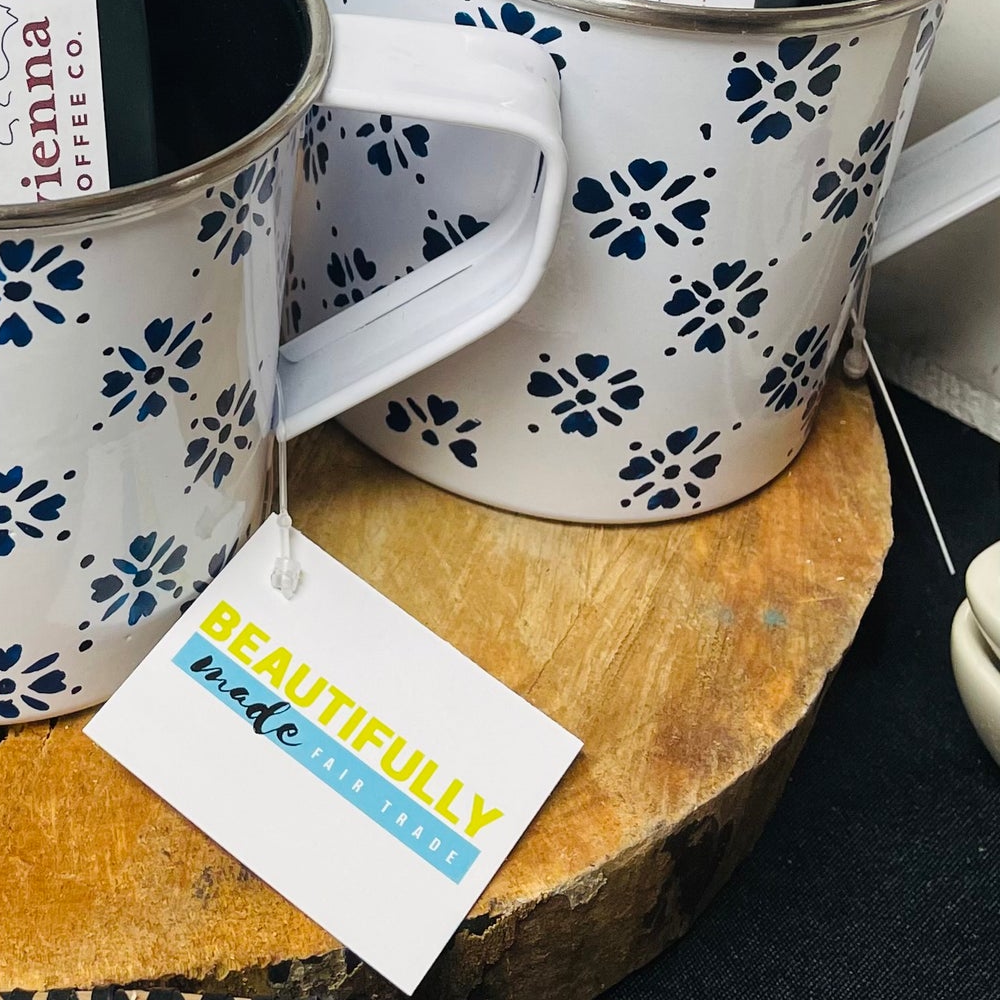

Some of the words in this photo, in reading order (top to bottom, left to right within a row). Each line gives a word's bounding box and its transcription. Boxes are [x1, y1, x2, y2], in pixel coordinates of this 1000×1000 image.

[66, 31, 85, 79] CO.
[70, 93, 93, 192] OFFEE
[190, 655, 303, 747] made
[311, 747, 365, 793] FAIR
[380, 800, 459, 865] TRADE
[200, 600, 505, 839] BEAUTIFULLY
